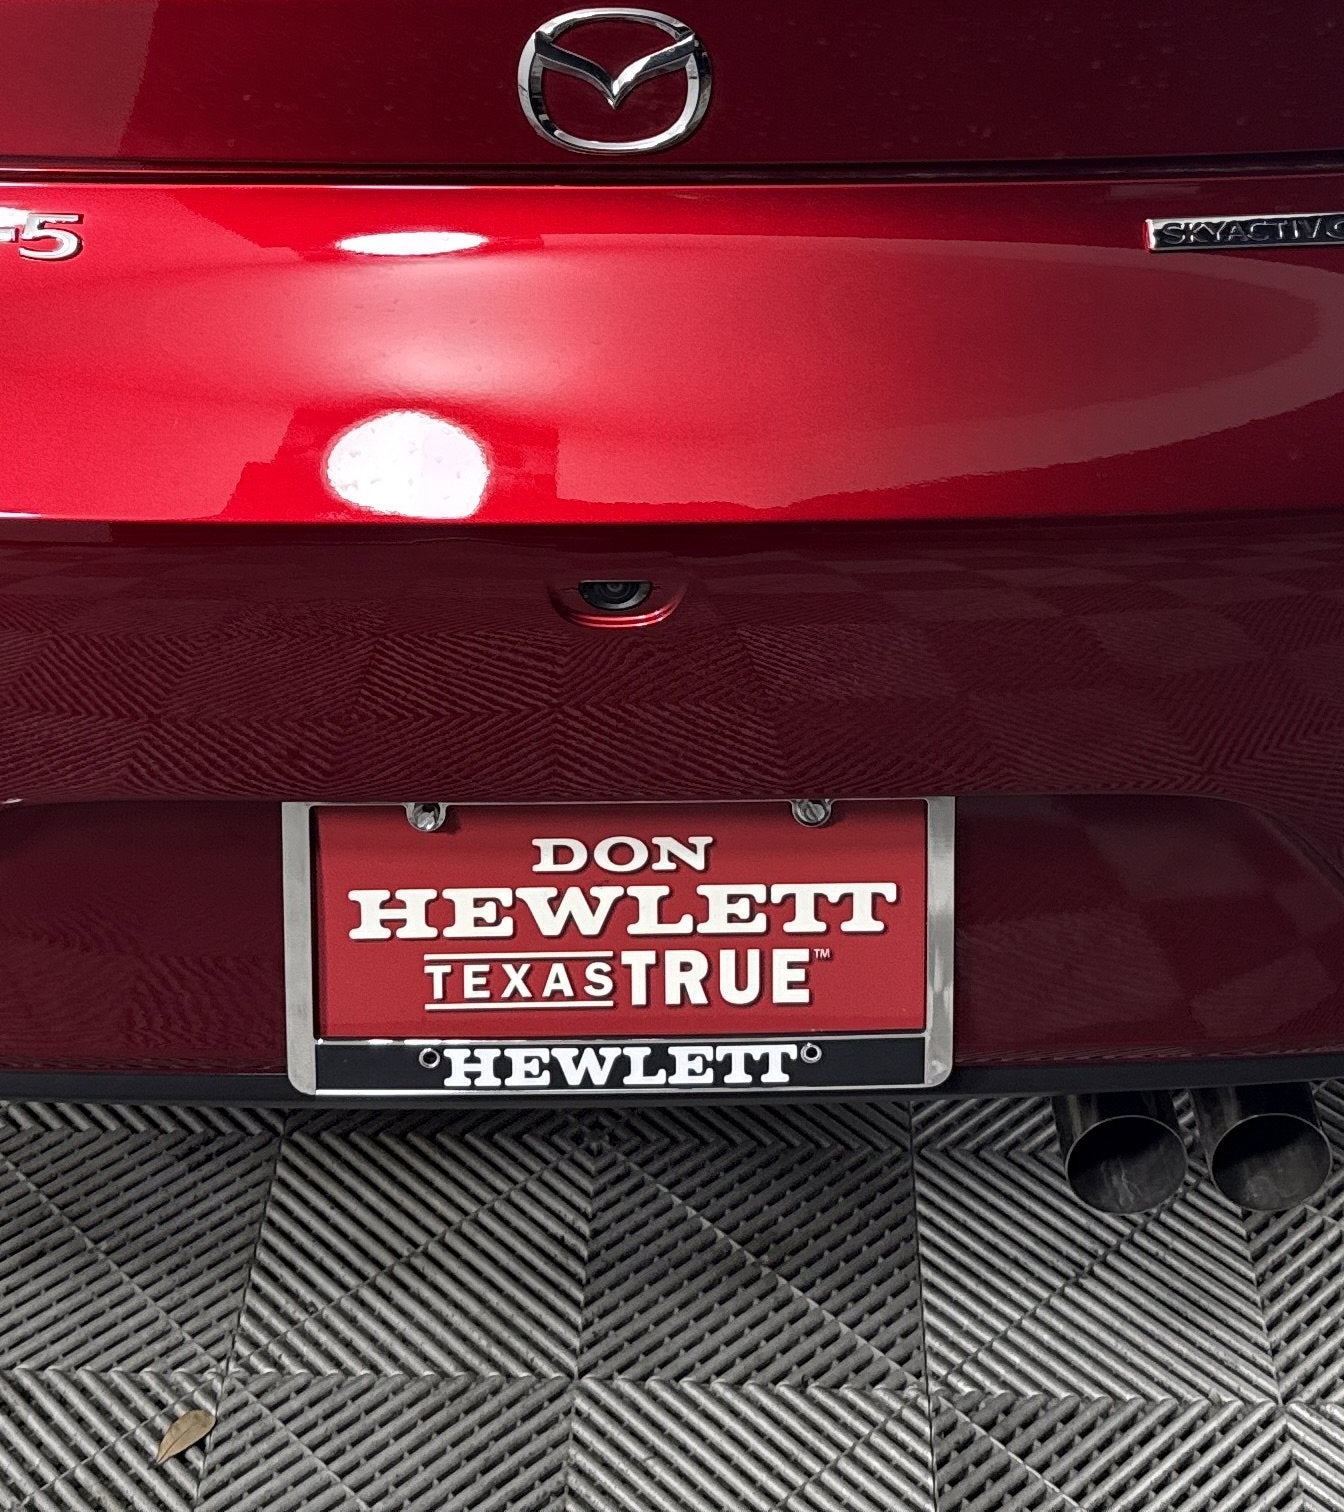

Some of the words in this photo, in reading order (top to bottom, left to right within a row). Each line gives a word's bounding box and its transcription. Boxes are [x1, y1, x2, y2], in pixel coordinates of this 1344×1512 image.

[531, 836, 714, 872] DON
[347, 883, 897, 940] HEWLETT
[442, 1043, 799, 1087] HEWLETT
